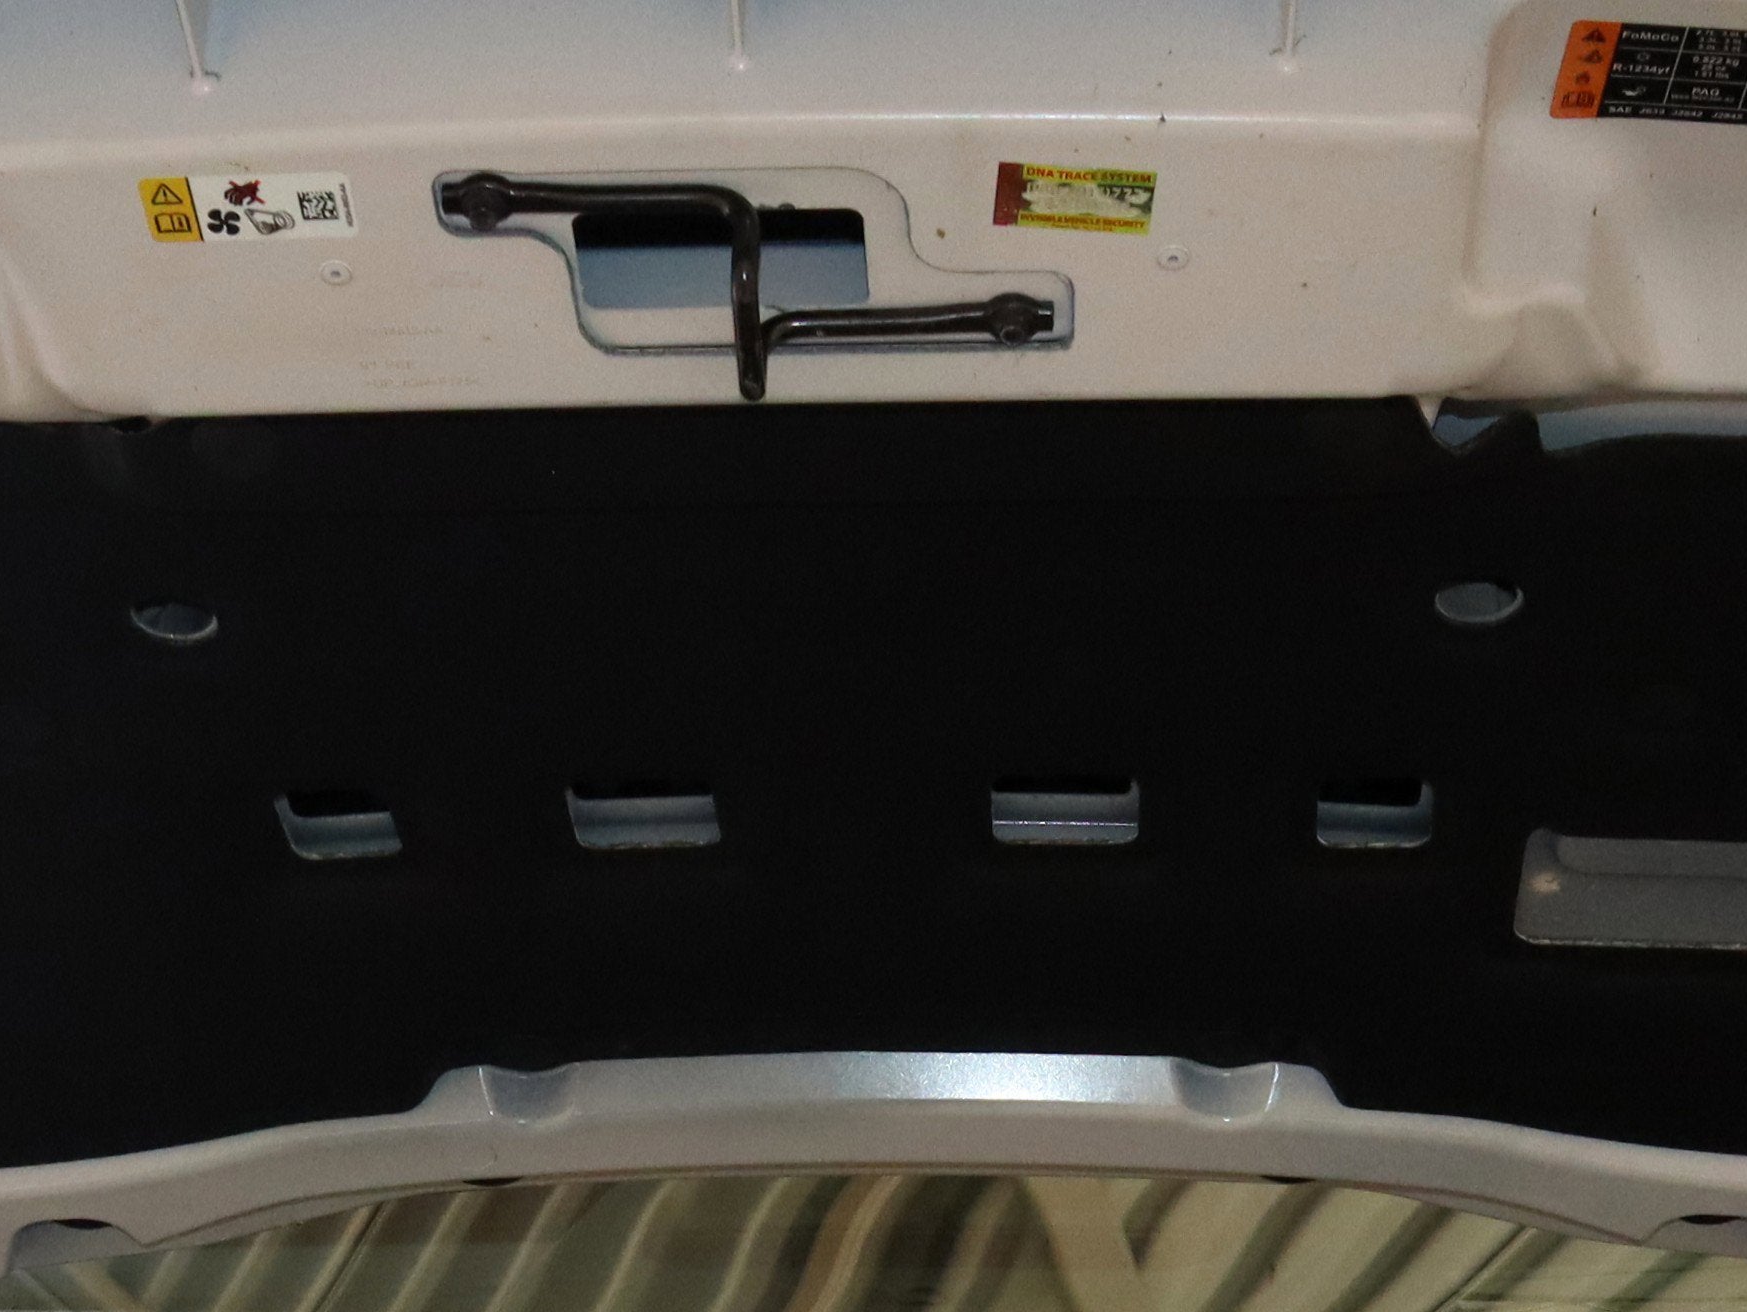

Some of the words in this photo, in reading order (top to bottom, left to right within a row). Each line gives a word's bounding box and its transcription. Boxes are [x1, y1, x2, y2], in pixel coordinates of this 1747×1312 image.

[1621, 30, 1680, 42] FoMoCo
[1726, 57, 1741, 67] kg
[1611, 62, 1671, 75] R-1234yf
[1608, 105, 1633, 114] SAE
[1026, 166, 1054, 178] DNA
[1057, 169, 1097, 182] TRACE
[1100, 171, 1152, 184] SYSTEM
